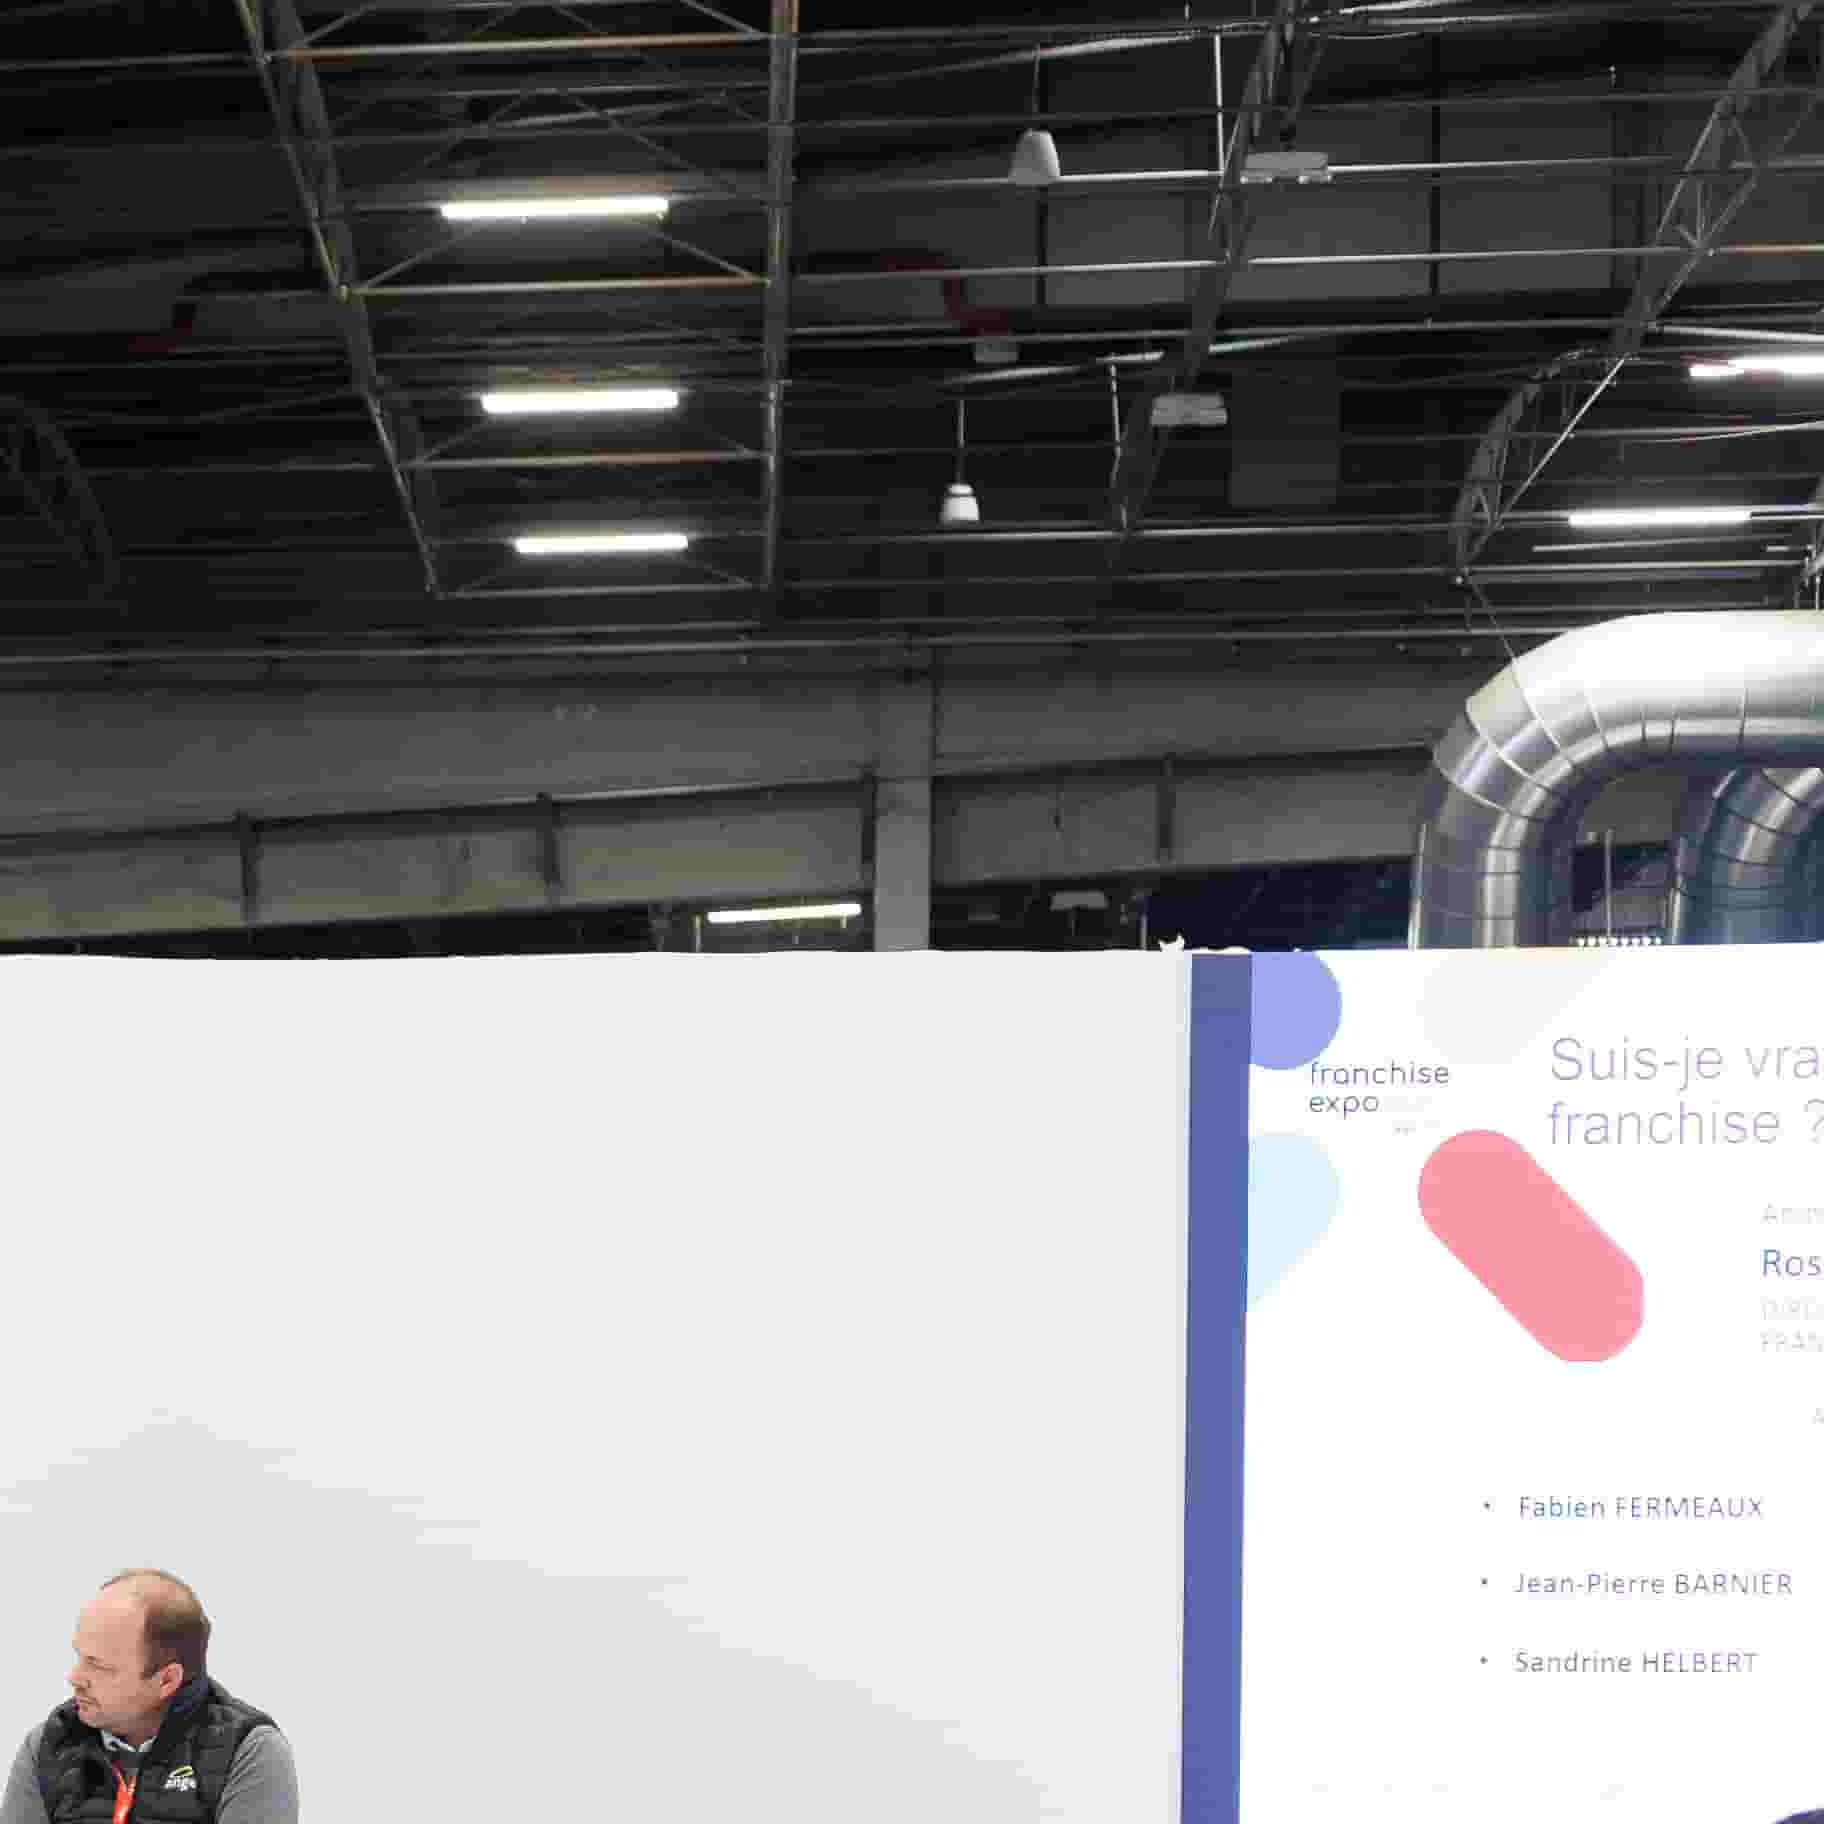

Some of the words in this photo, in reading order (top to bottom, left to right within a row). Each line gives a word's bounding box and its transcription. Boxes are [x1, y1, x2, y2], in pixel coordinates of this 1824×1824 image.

[1310, 1061, 1450, 1086] franchise
[1551, 1035, 1724, 1092] Suis-je
[1309, 1095, 1380, 1120] expo
[1547, 1100, 1780, 1145] franchise
[1519, 1496, 1605, 1519] Fabien
[1615, 1496, 1763, 1520] FERMEAUX
[1514, 1572, 1665, 1596] Jean-Pierre
[1674, 1573, 1793, 1596] BARNIER
[1515, 1648, 1633, 1673] Sandrine
[1641, 1651, 1759, 1673] HELBERT
